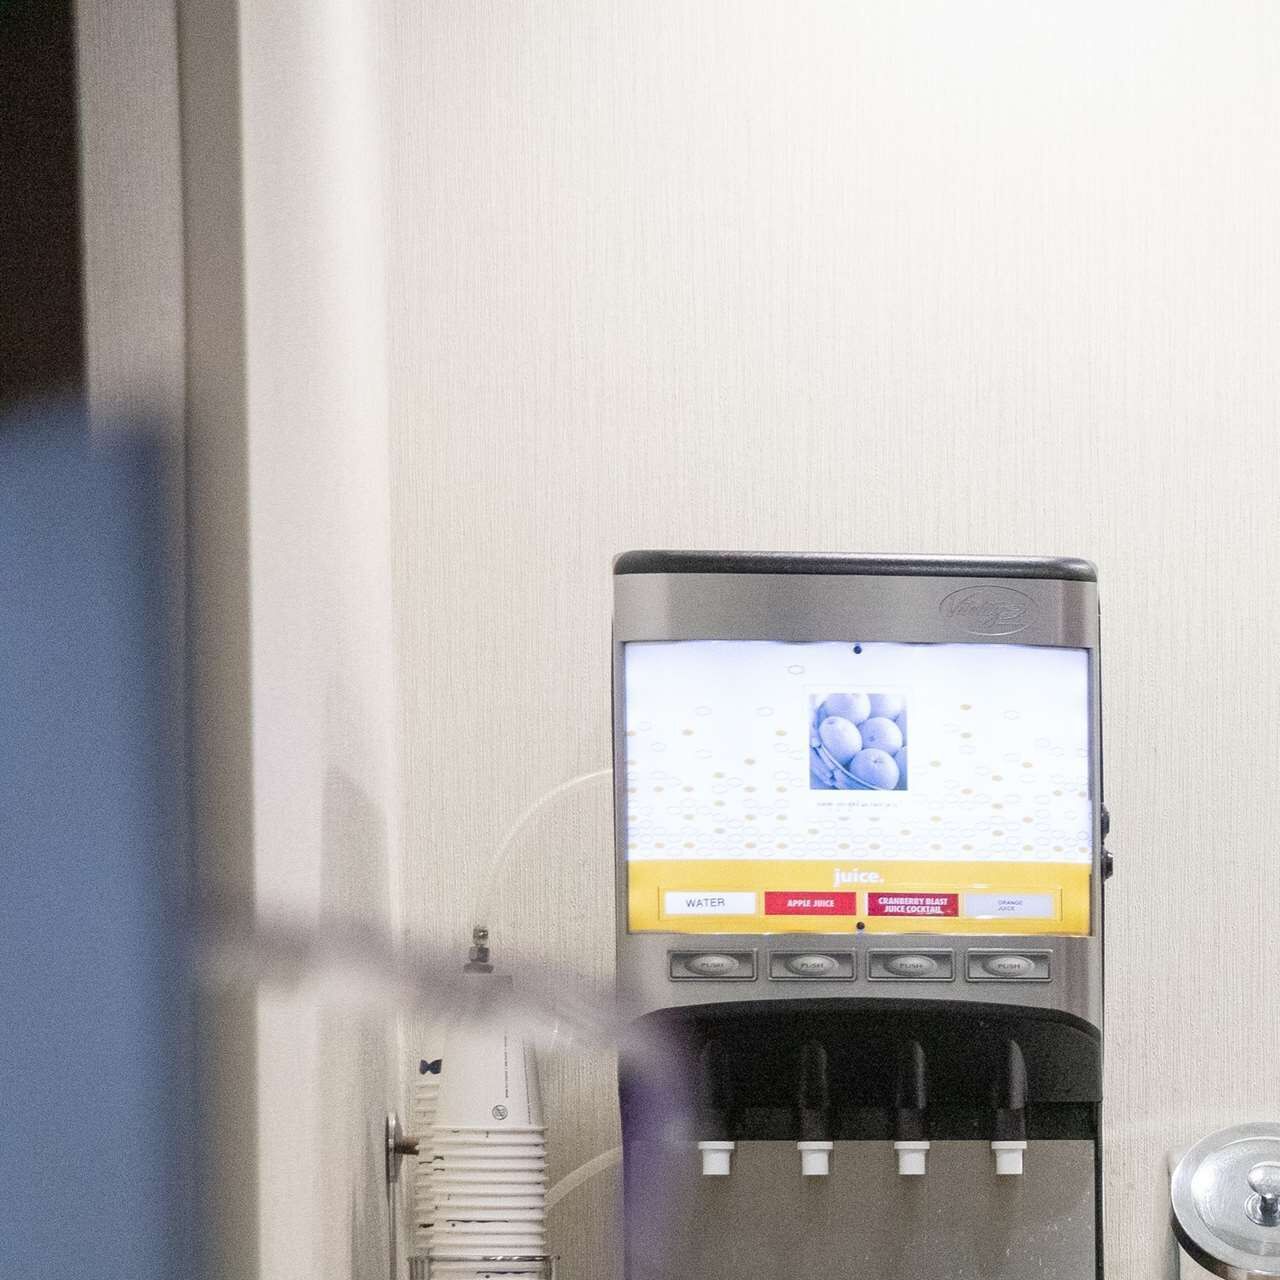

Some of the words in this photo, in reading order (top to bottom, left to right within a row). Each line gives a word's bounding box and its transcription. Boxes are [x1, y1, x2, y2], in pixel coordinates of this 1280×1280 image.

[832, 868, 885, 888] juice.
[686, 897, 726, 908] WATER
[786, 899, 811, 908] APPLE
[812, 899, 835, 908] JUICE
[878, 896, 925, 906] CRANBERRY
[925, 897, 948, 906] BLAST
[884, 905, 906, 913] JUICE
